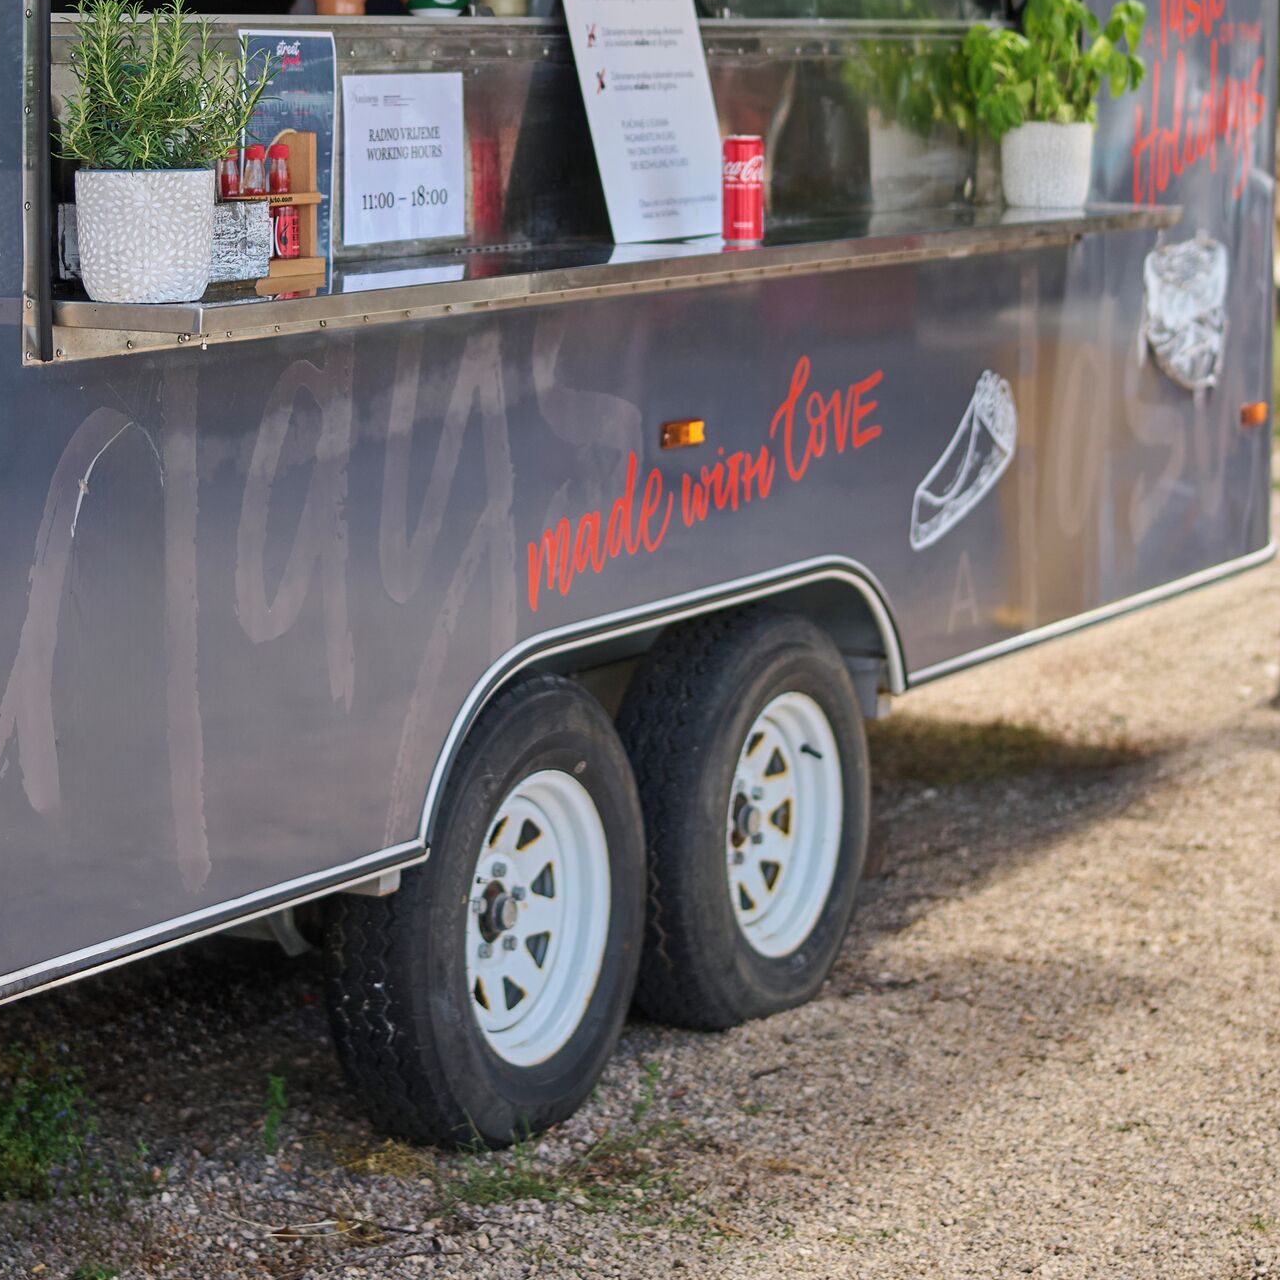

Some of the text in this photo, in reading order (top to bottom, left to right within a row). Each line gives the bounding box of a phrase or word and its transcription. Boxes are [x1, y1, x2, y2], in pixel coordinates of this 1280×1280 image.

[368, 125, 441, 142] RADNO VRIJEME
[1132, 56, 1265, 212] Holidays
[366, 144, 443, 161] WORKING HOURS
[362, 191, 395, 210] 11:00
[411, 184, 448, 207] 18:00
[528, 451, 673, 612] made
